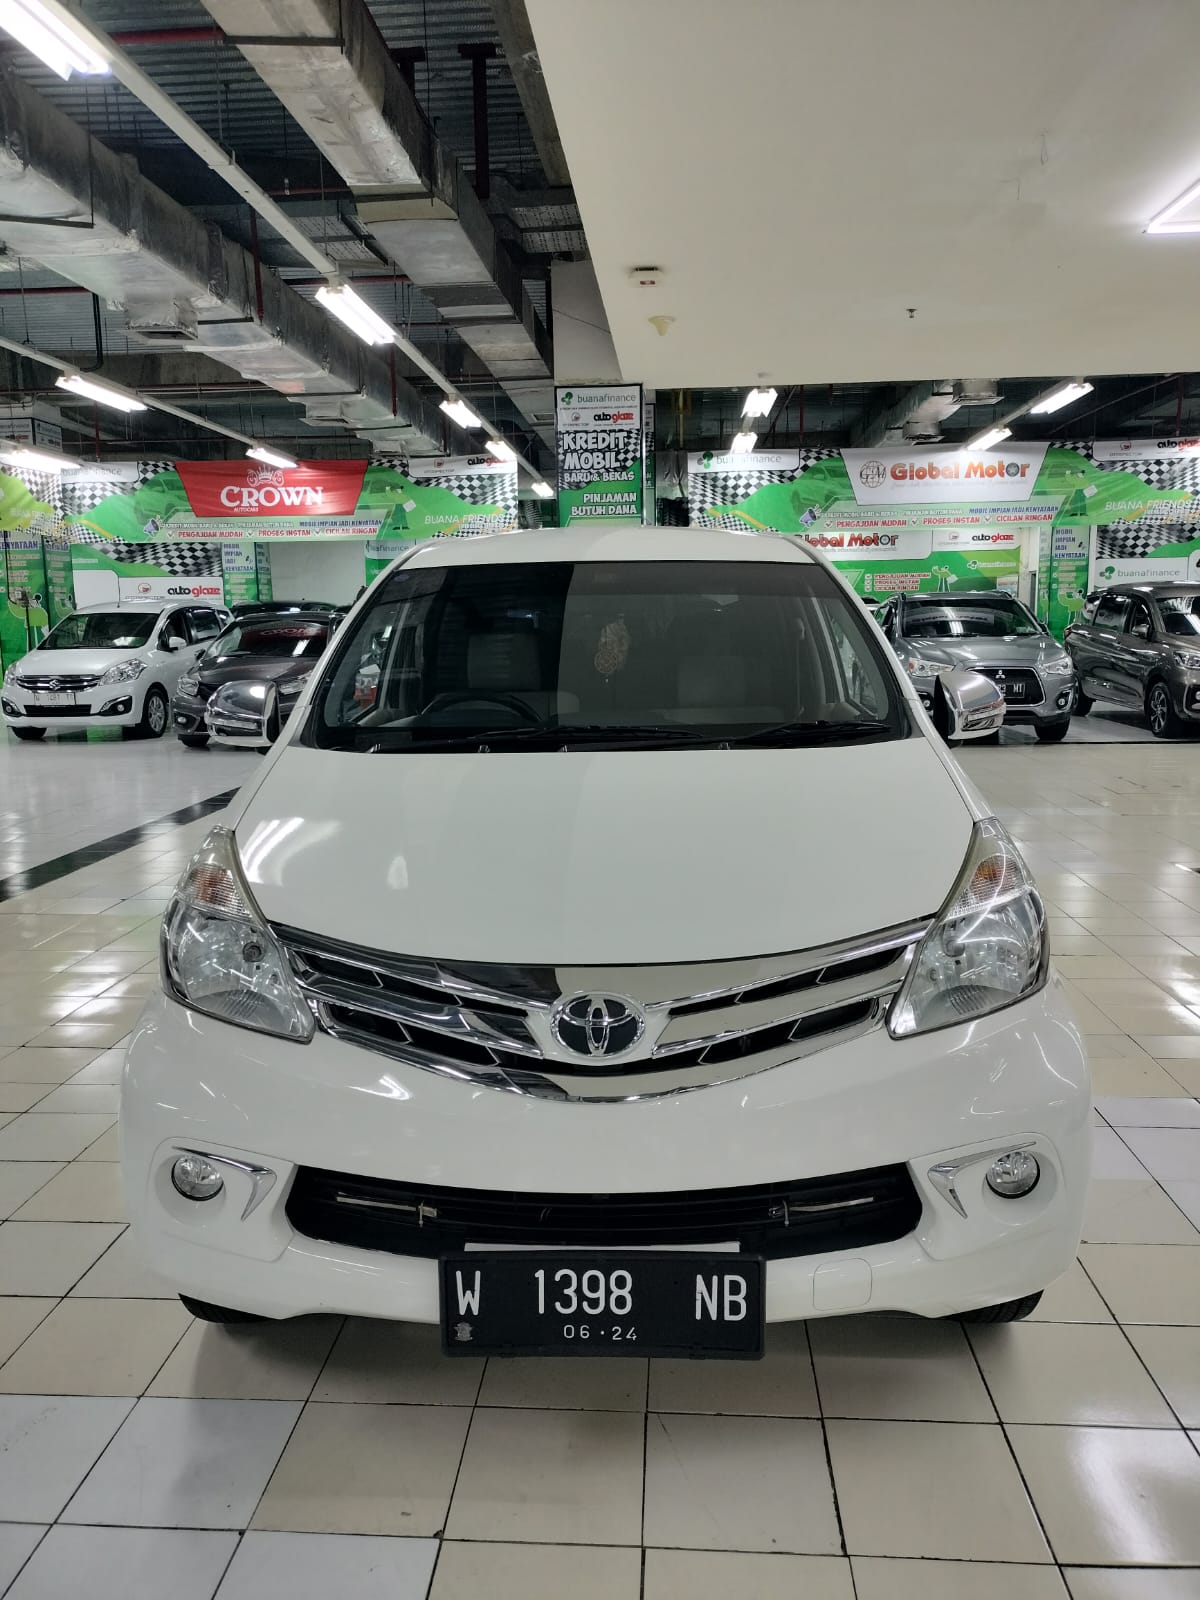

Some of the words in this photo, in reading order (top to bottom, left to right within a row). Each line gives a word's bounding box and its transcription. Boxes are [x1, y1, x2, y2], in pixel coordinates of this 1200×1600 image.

[577, 393, 636, 403] buanafinance
[563, 431, 627, 450] KREDIT
[563, 451, 621, 470] MOBIL
[890, 460, 960, 481] Global
[964, 460, 1031, 479] Motor
[564, 471, 591, 483] BARU
[592, 472, 600, 481] &
[602, 471, 635, 482] BEKAS
[220, 485, 324, 508] CROWN
[583, 492, 637, 504] PINJAMAN
[571, 505, 606, 516] BUTUH
[608, 504, 637, 515] DANA
[1105, 500, 1143, 511] BUANA
[424, 514, 459, 525] BUANA
[881, 519, 906, 527] MUDAH
[953, 516, 980, 524] INSTAN
[220, 530, 243, 538] MUDAH
[352, 527, 378, 535] RINGAN
[0, 541, 38, 550] ENYATAAN
[795, 532, 845, 548] lobal
[847, 532, 899, 548] Motor
[1117, 565, 1180, 578] buanafinance
[167, 585, 221, 597] autoglaze
[455, 1270, 481, 1316] W
[534, 1268, 633, 1315] 1398
[695, 1274, 748, 1321] NB
